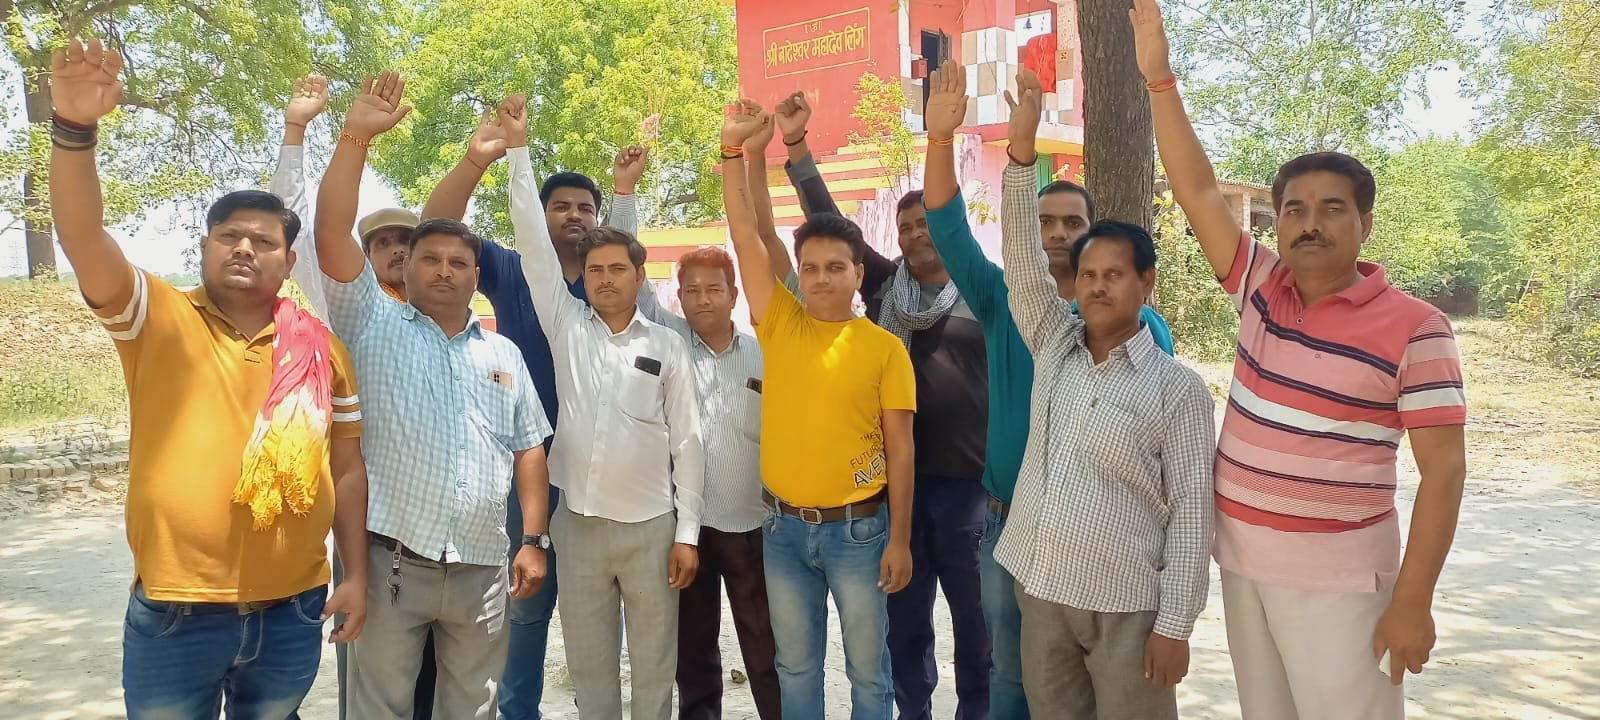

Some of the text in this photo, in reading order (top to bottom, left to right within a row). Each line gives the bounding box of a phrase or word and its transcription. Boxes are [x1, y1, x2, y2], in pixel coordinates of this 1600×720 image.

[766, 41, 778, 68] श्री
[811, 29, 843, 57] महादेव
[844, 23, 867, 52] लिंग
